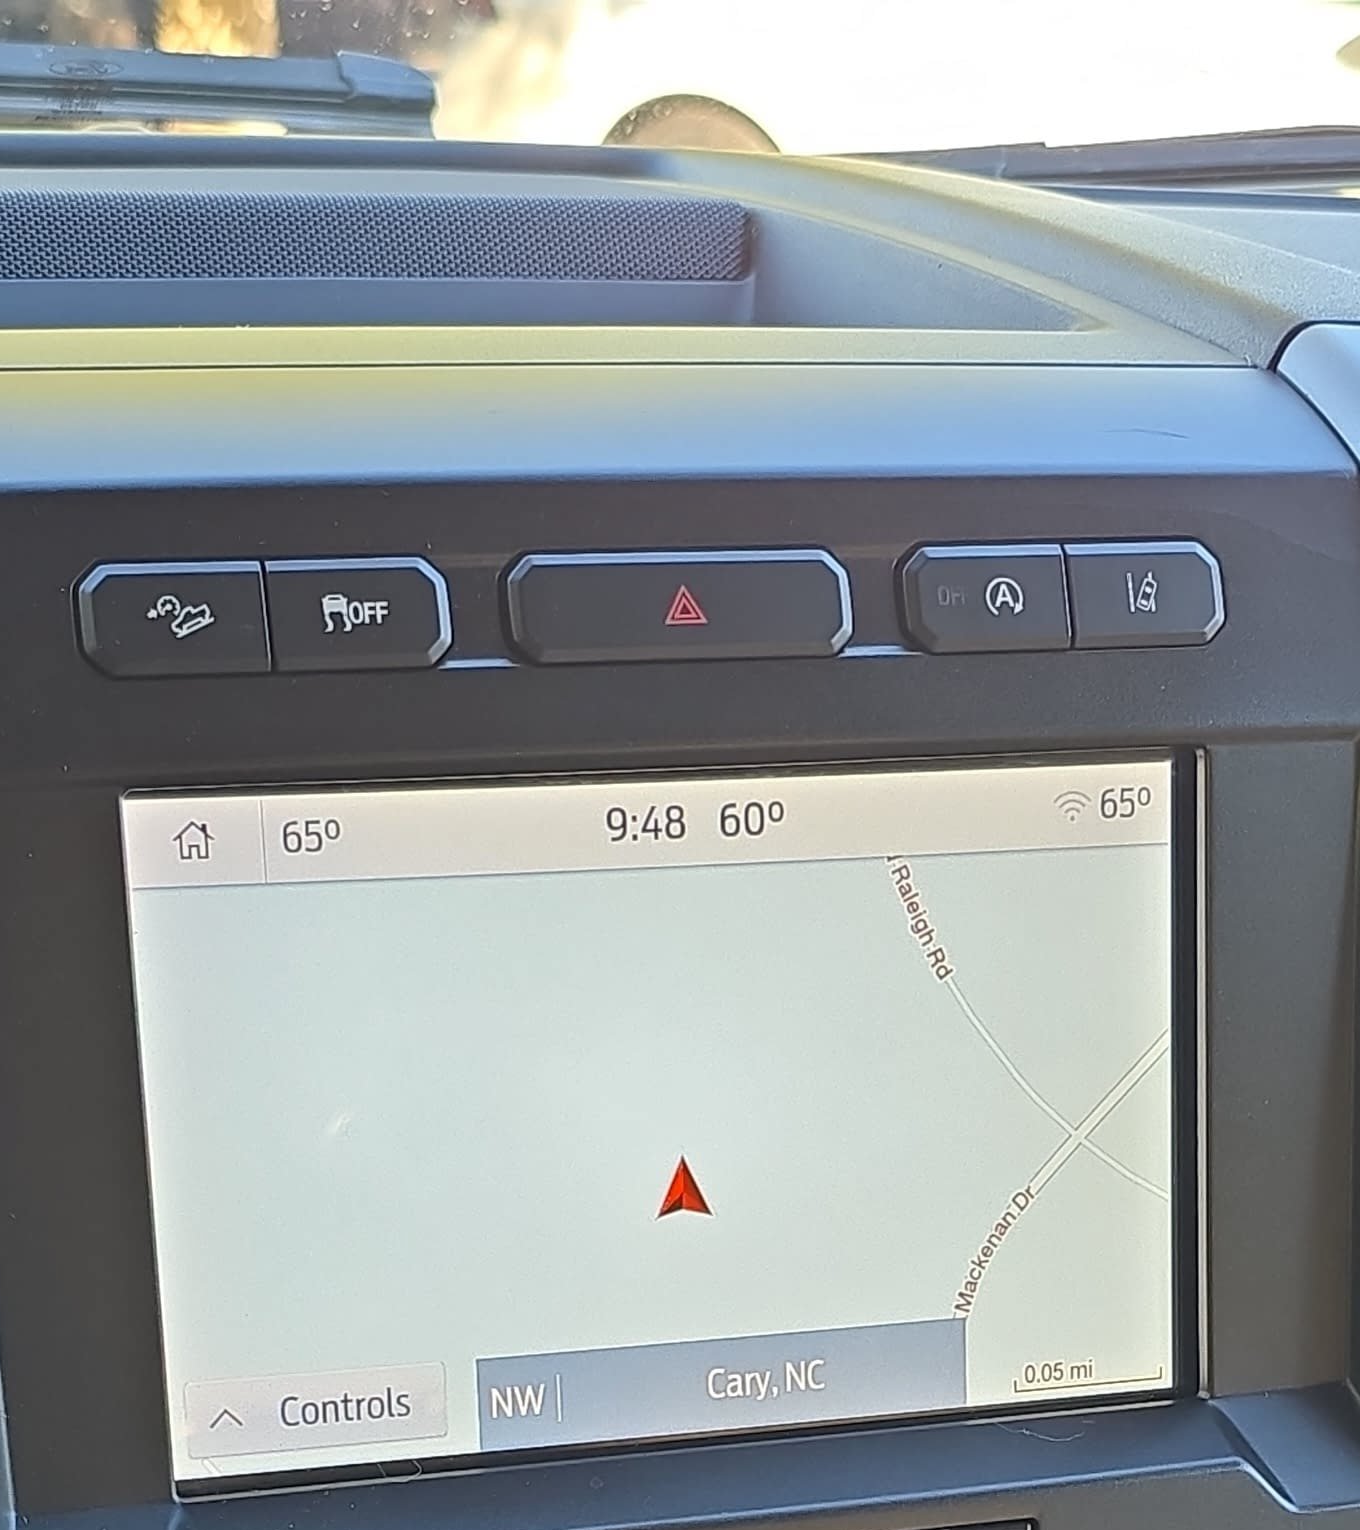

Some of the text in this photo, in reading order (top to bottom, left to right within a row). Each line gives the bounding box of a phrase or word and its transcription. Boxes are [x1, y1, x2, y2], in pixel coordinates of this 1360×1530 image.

[351, 599, 390, 626] OFF
[604, 803, 688, 844] 9:48
[891, 864, 936, 948] Raleigh
[926, 946, 954, 981] Rd
[953, 1185, 1036, 1314] Mackenan Dr
[489, 1384, 546, 1420] NW
[784, 1359, 826, 1393] NC
[1023, 1359, 1094, 1384] 0.05 mi
[278, 1387, 412, 1429] Controls
